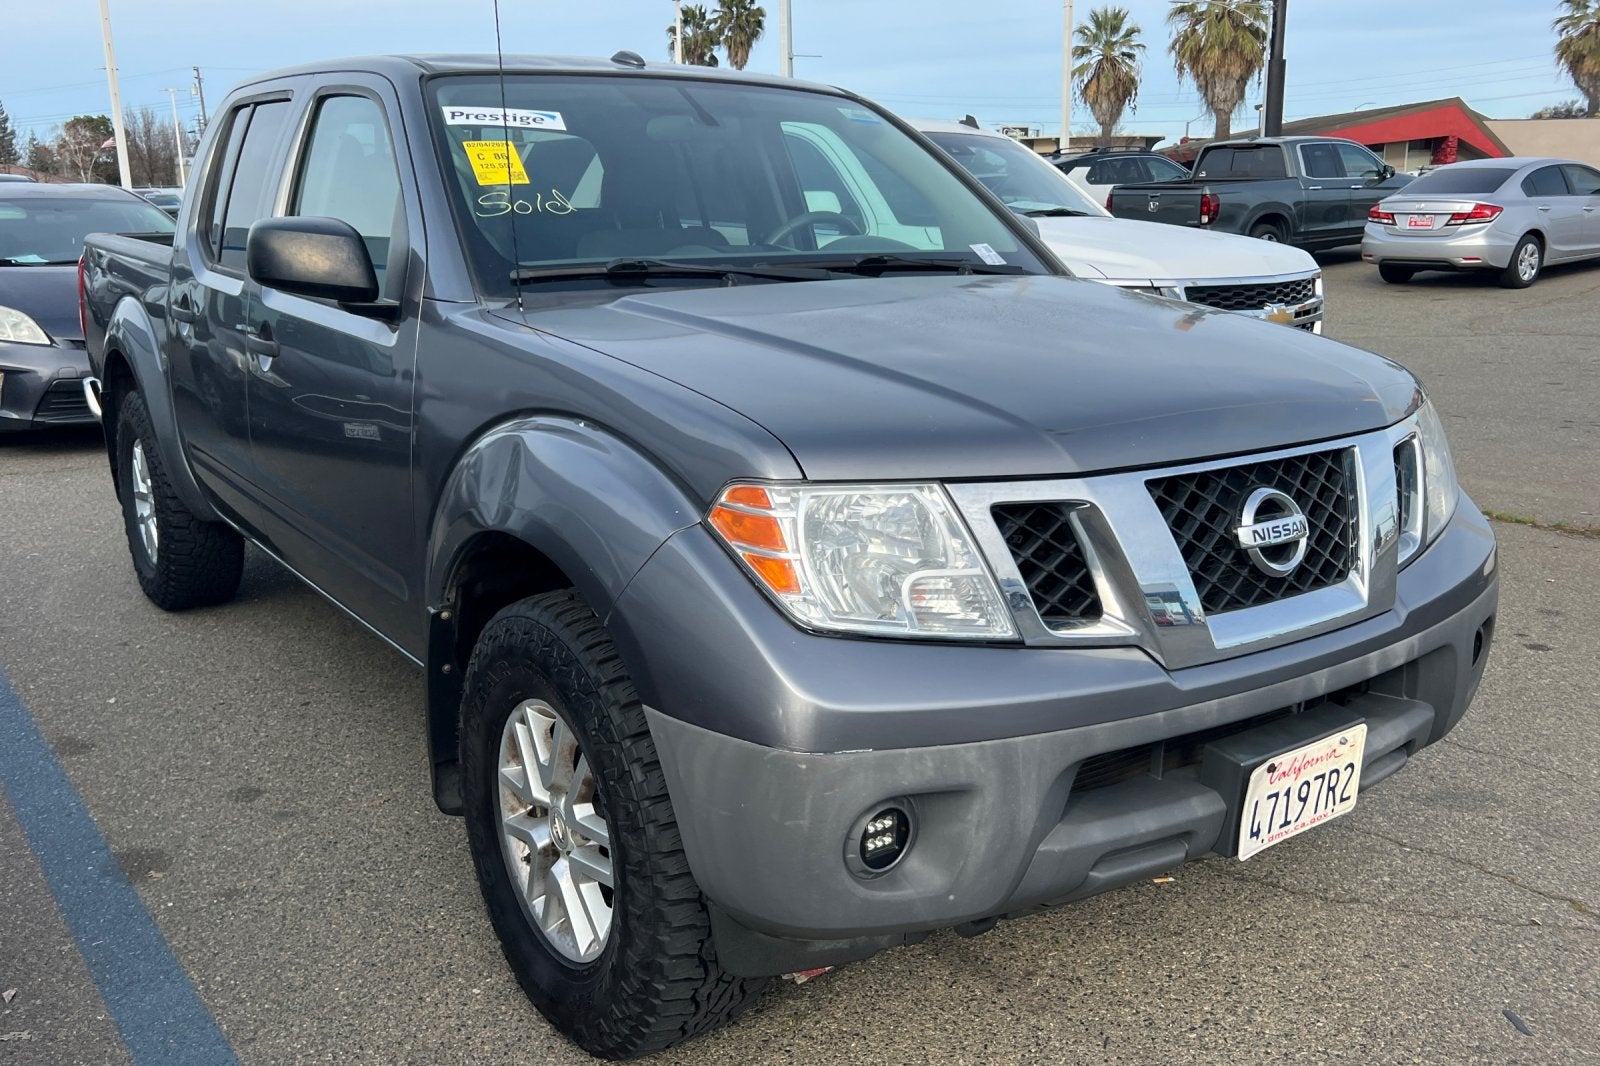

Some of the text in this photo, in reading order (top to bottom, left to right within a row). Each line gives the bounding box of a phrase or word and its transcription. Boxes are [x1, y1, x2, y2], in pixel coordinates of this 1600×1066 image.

[449, 110, 545, 126] Prestige
[477, 152, 486, 161] C
[475, 188, 578, 217] Sold
[1252, 519, 1307, 543] NISSAN
[1266, 747, 1343, 785] California
[1249, 761, 1355, 841] 47197R2
[1267, 811, 1329, 842] dmv.ca.gov
